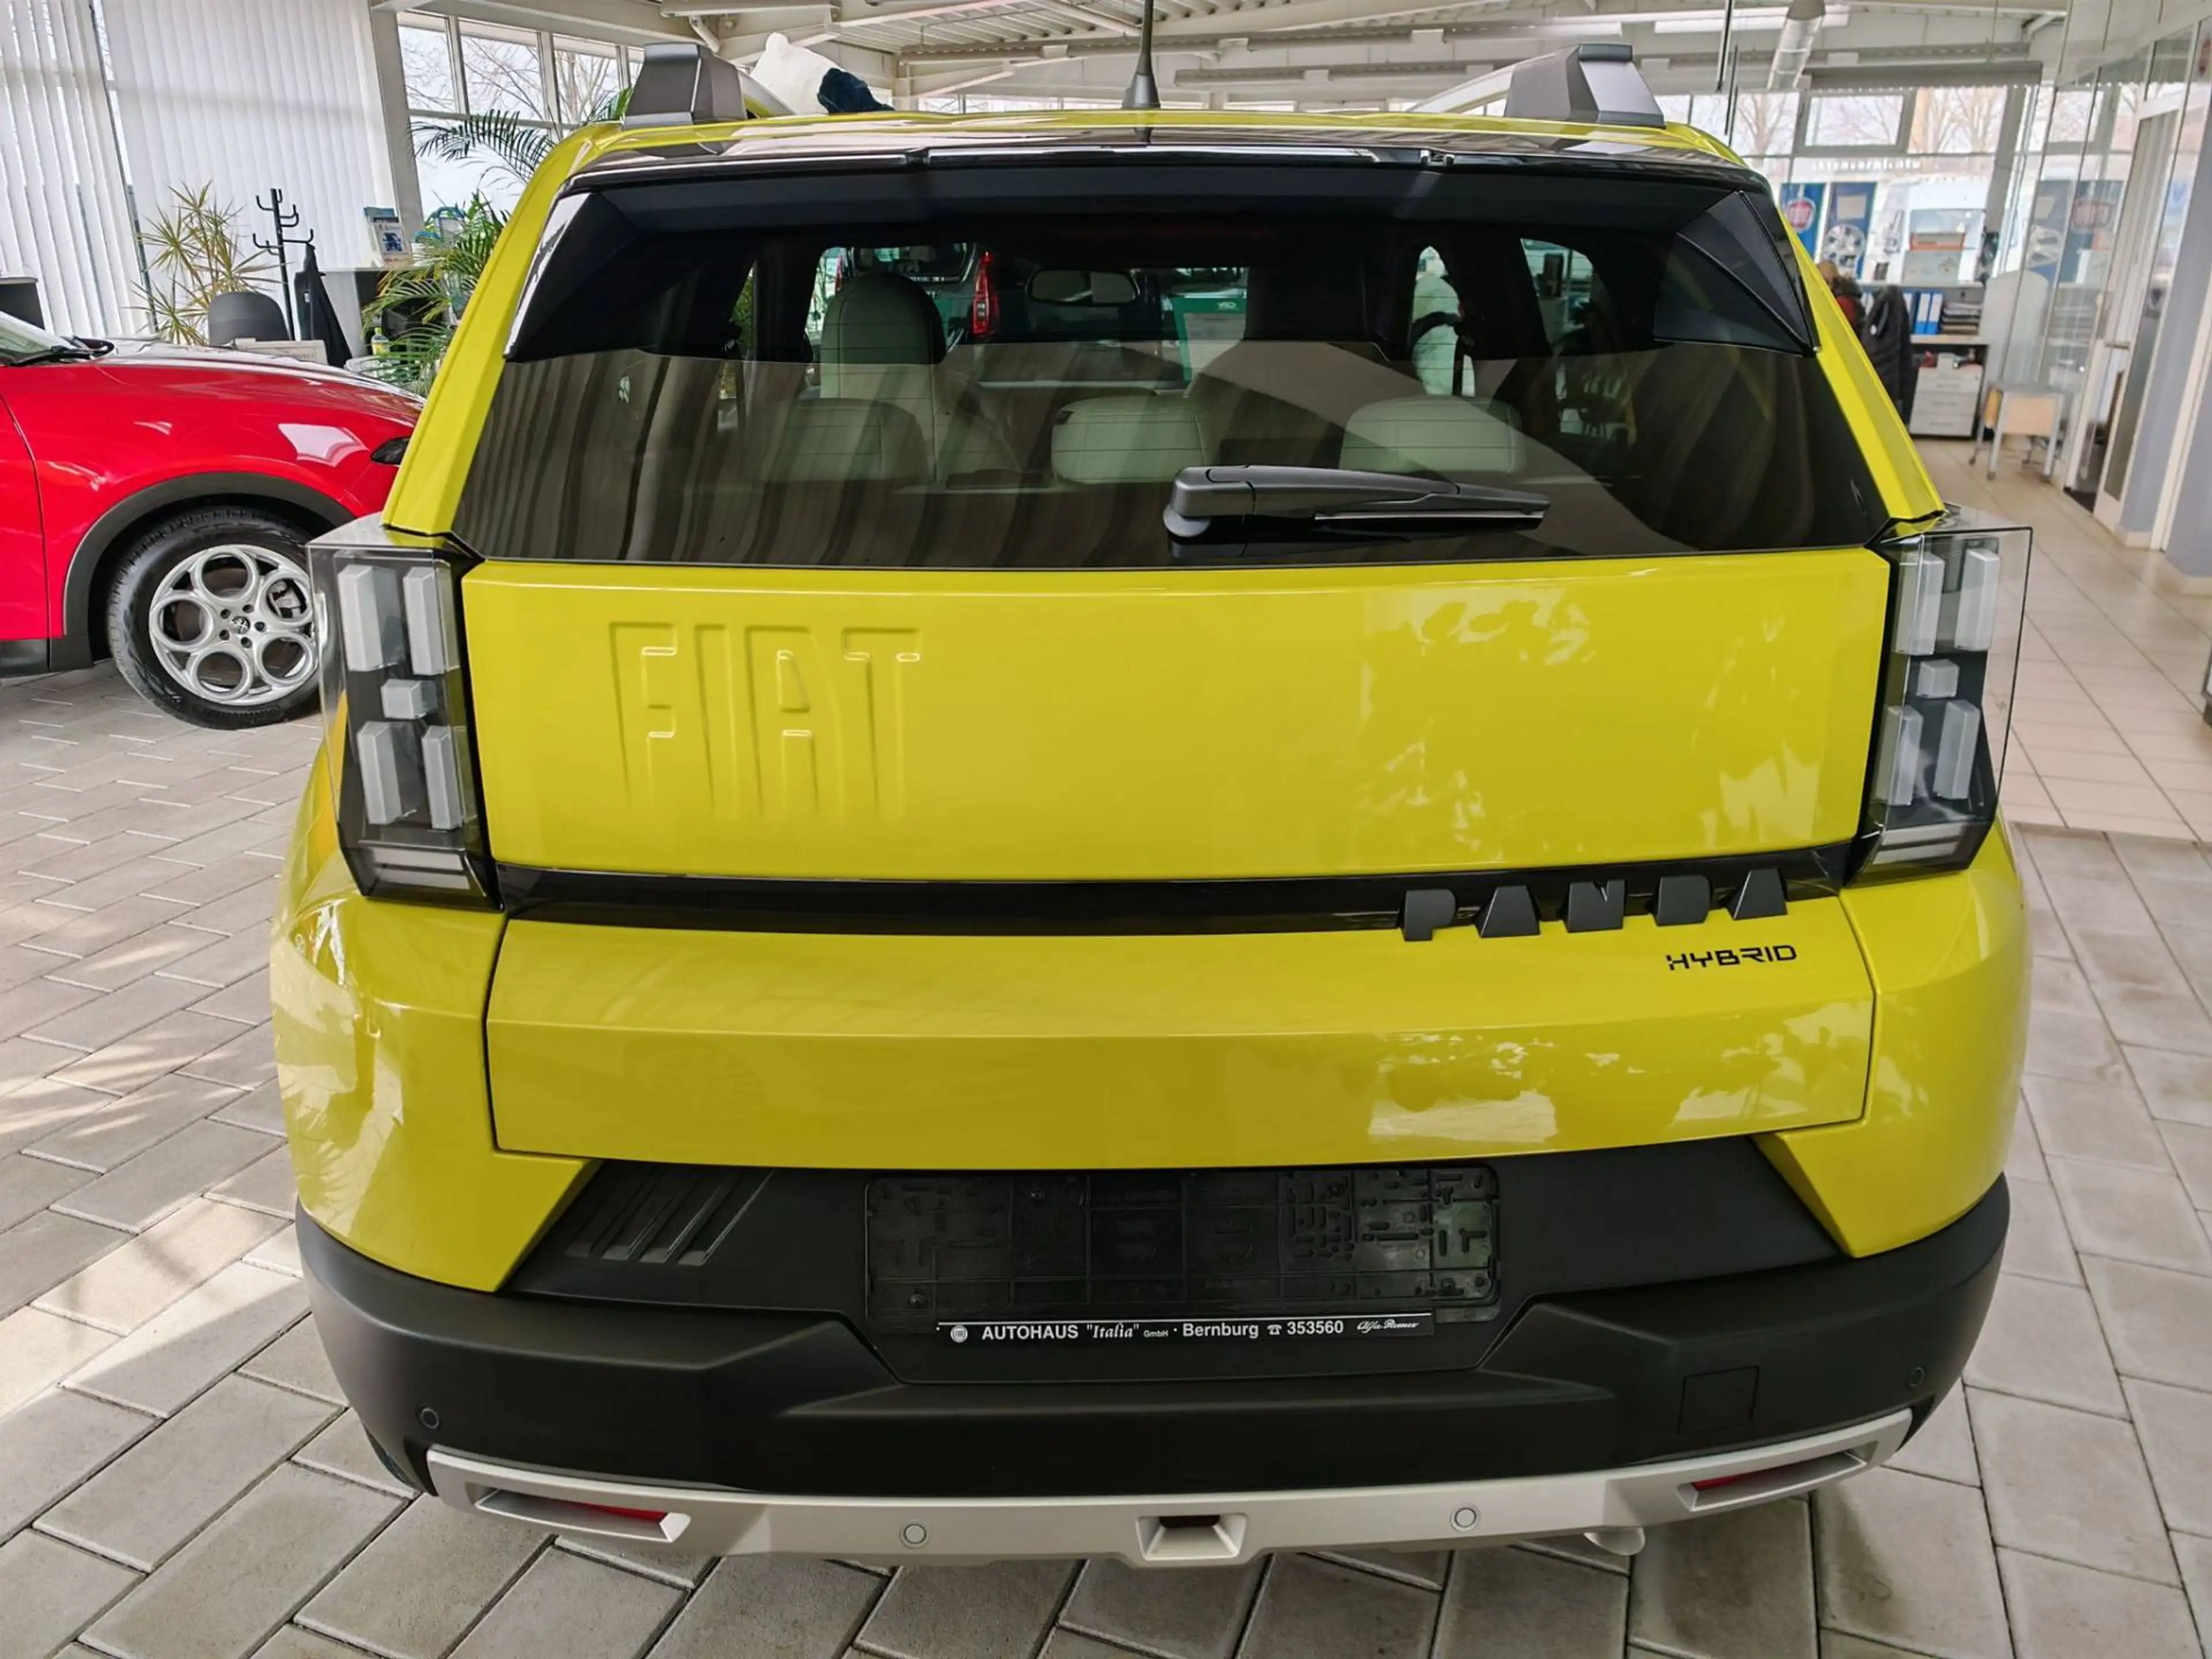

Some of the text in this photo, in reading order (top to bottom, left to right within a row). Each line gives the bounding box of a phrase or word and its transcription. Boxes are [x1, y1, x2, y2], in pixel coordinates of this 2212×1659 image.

[608, 622, 921, 819] FIAT
[1403, 867, 1788, 942] PANDA
[1666, 944, 1797, 971] HYBRID
[981, 1324, 1079, 1340] AUTOHAUS
[1086, 1323, 1139, 1339] "Italia"
[1143, 1330, 1169, 1338] GmbH
[1182, 1323, 1259, 1339] Bernburg
[1286, 1320, 1344, 1335] 353560
[1356, 1320, 1383, 1334] Alfa
